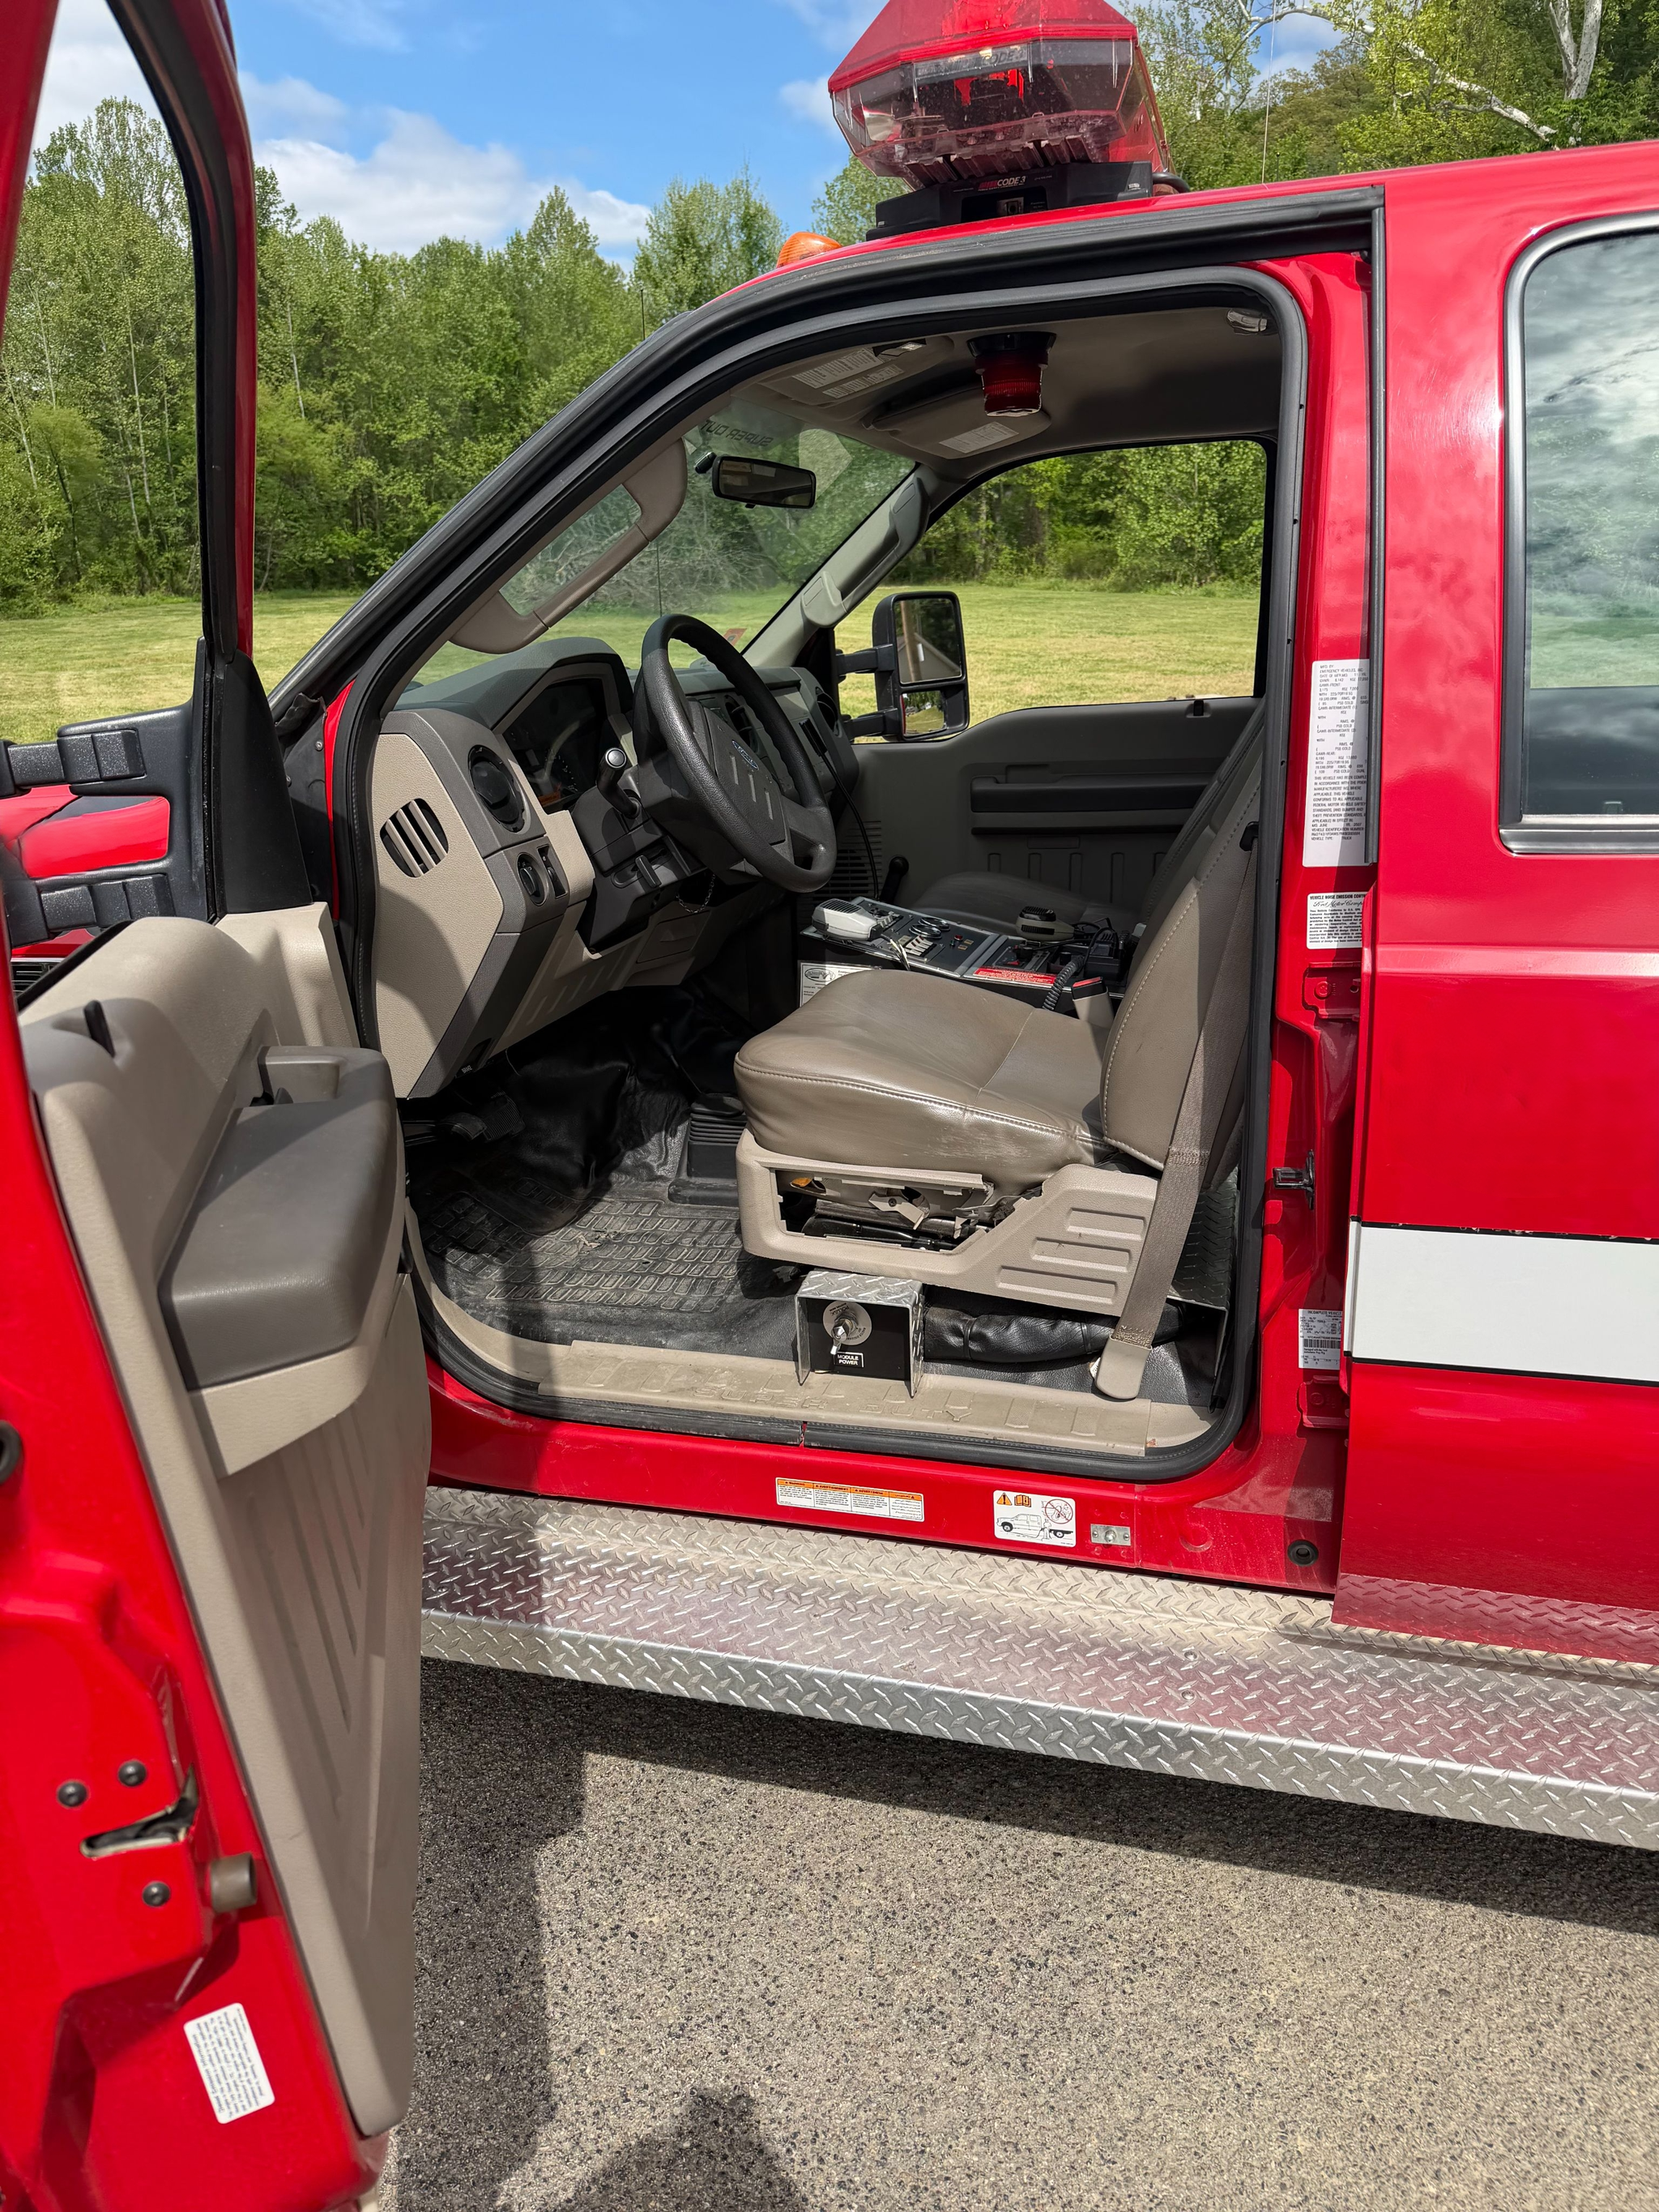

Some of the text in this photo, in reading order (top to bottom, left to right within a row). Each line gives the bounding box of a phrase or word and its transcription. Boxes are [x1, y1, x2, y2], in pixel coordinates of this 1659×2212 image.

[996, 177, 1021, 186] CODE
[693, 1387, 971, 1421] SUPER DUTY
